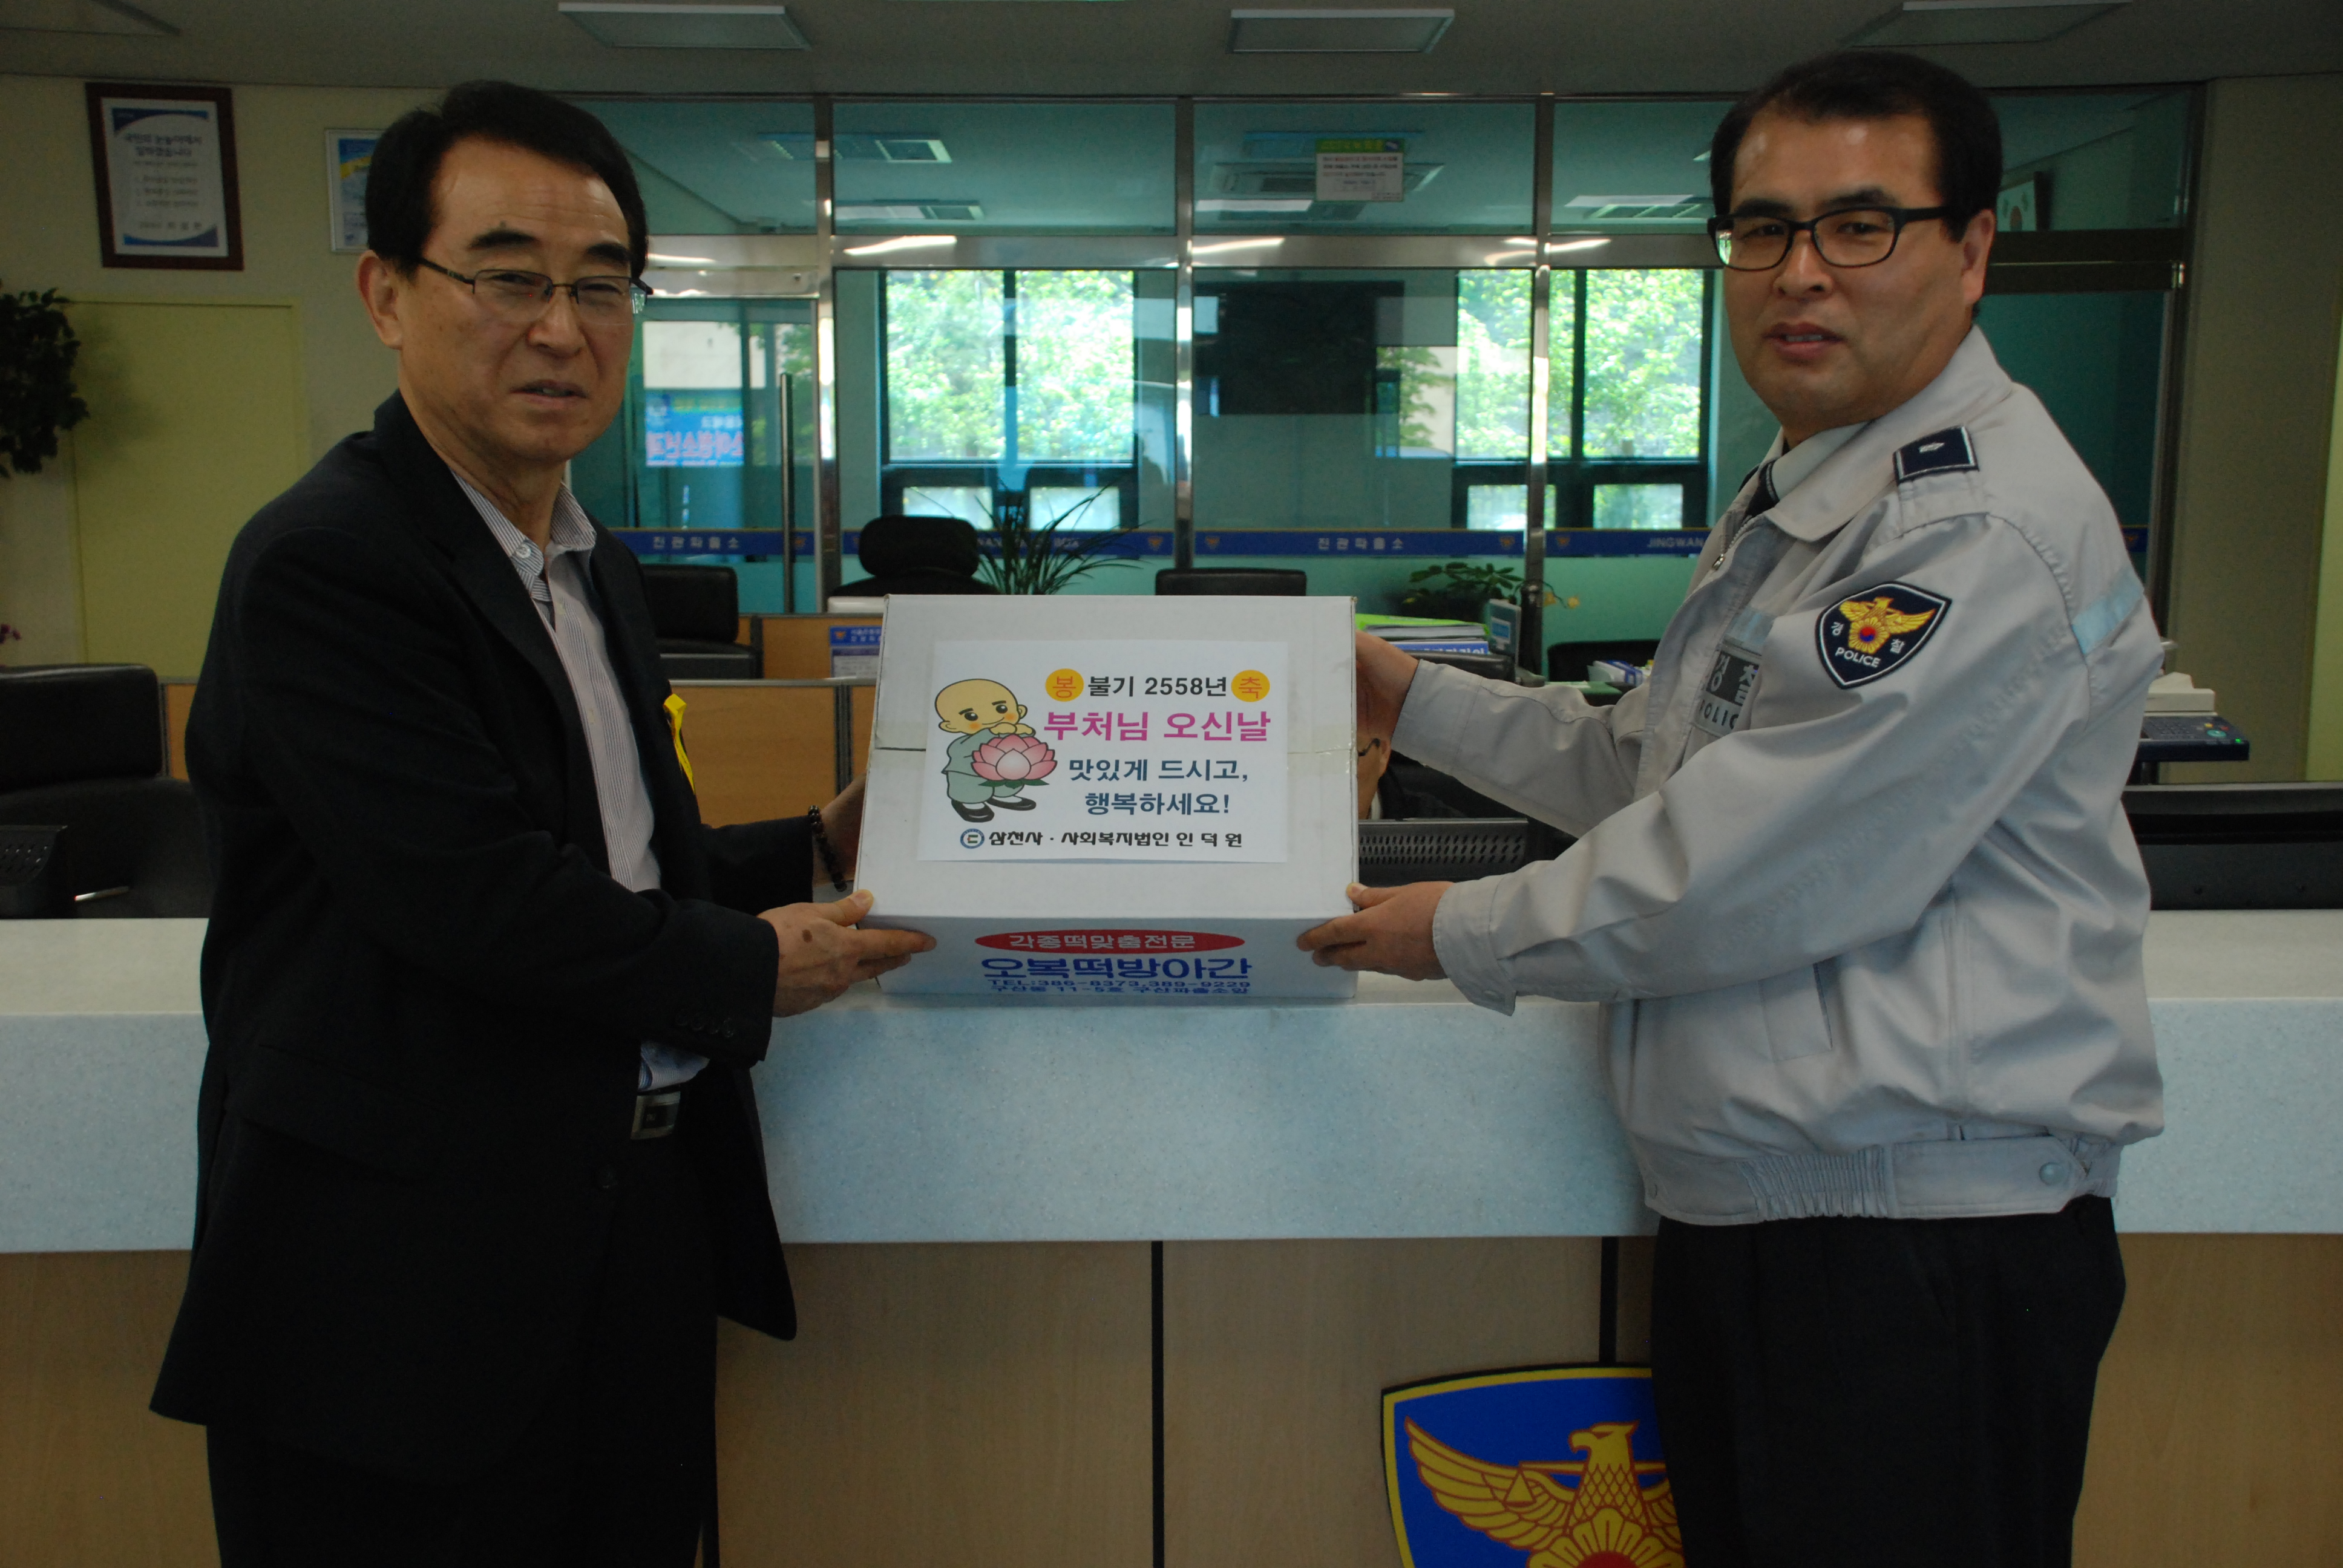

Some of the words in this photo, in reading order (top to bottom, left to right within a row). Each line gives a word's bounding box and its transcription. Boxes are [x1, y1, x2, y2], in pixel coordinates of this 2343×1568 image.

[1835, 646, 1882, 668] POLICE
[1052, 676, 1076, 698] 봉
[1088, 676, 1134, 697] 불기
[1145, 676, 1227, 697] 2558년
[1238, 677, 1262, 699] 축
[1043, 711, 1149, 741] 부처님
[1164, 711, 1271, 741] 오신날
[1070, 759, 1148, 781] 맛있게
[1158, 759, 1248, 782] 드시고,
[1085, 792, 1230, 815] 행복하세요!
[989, 831, 1043, 846] 삼천사
[1061, 832, 1169, 846] 사회복지법인
[1009, 935, 1196, 949] 각종떡맞춤전문
[981, 958, 1252, 979] 오복떡방아간
